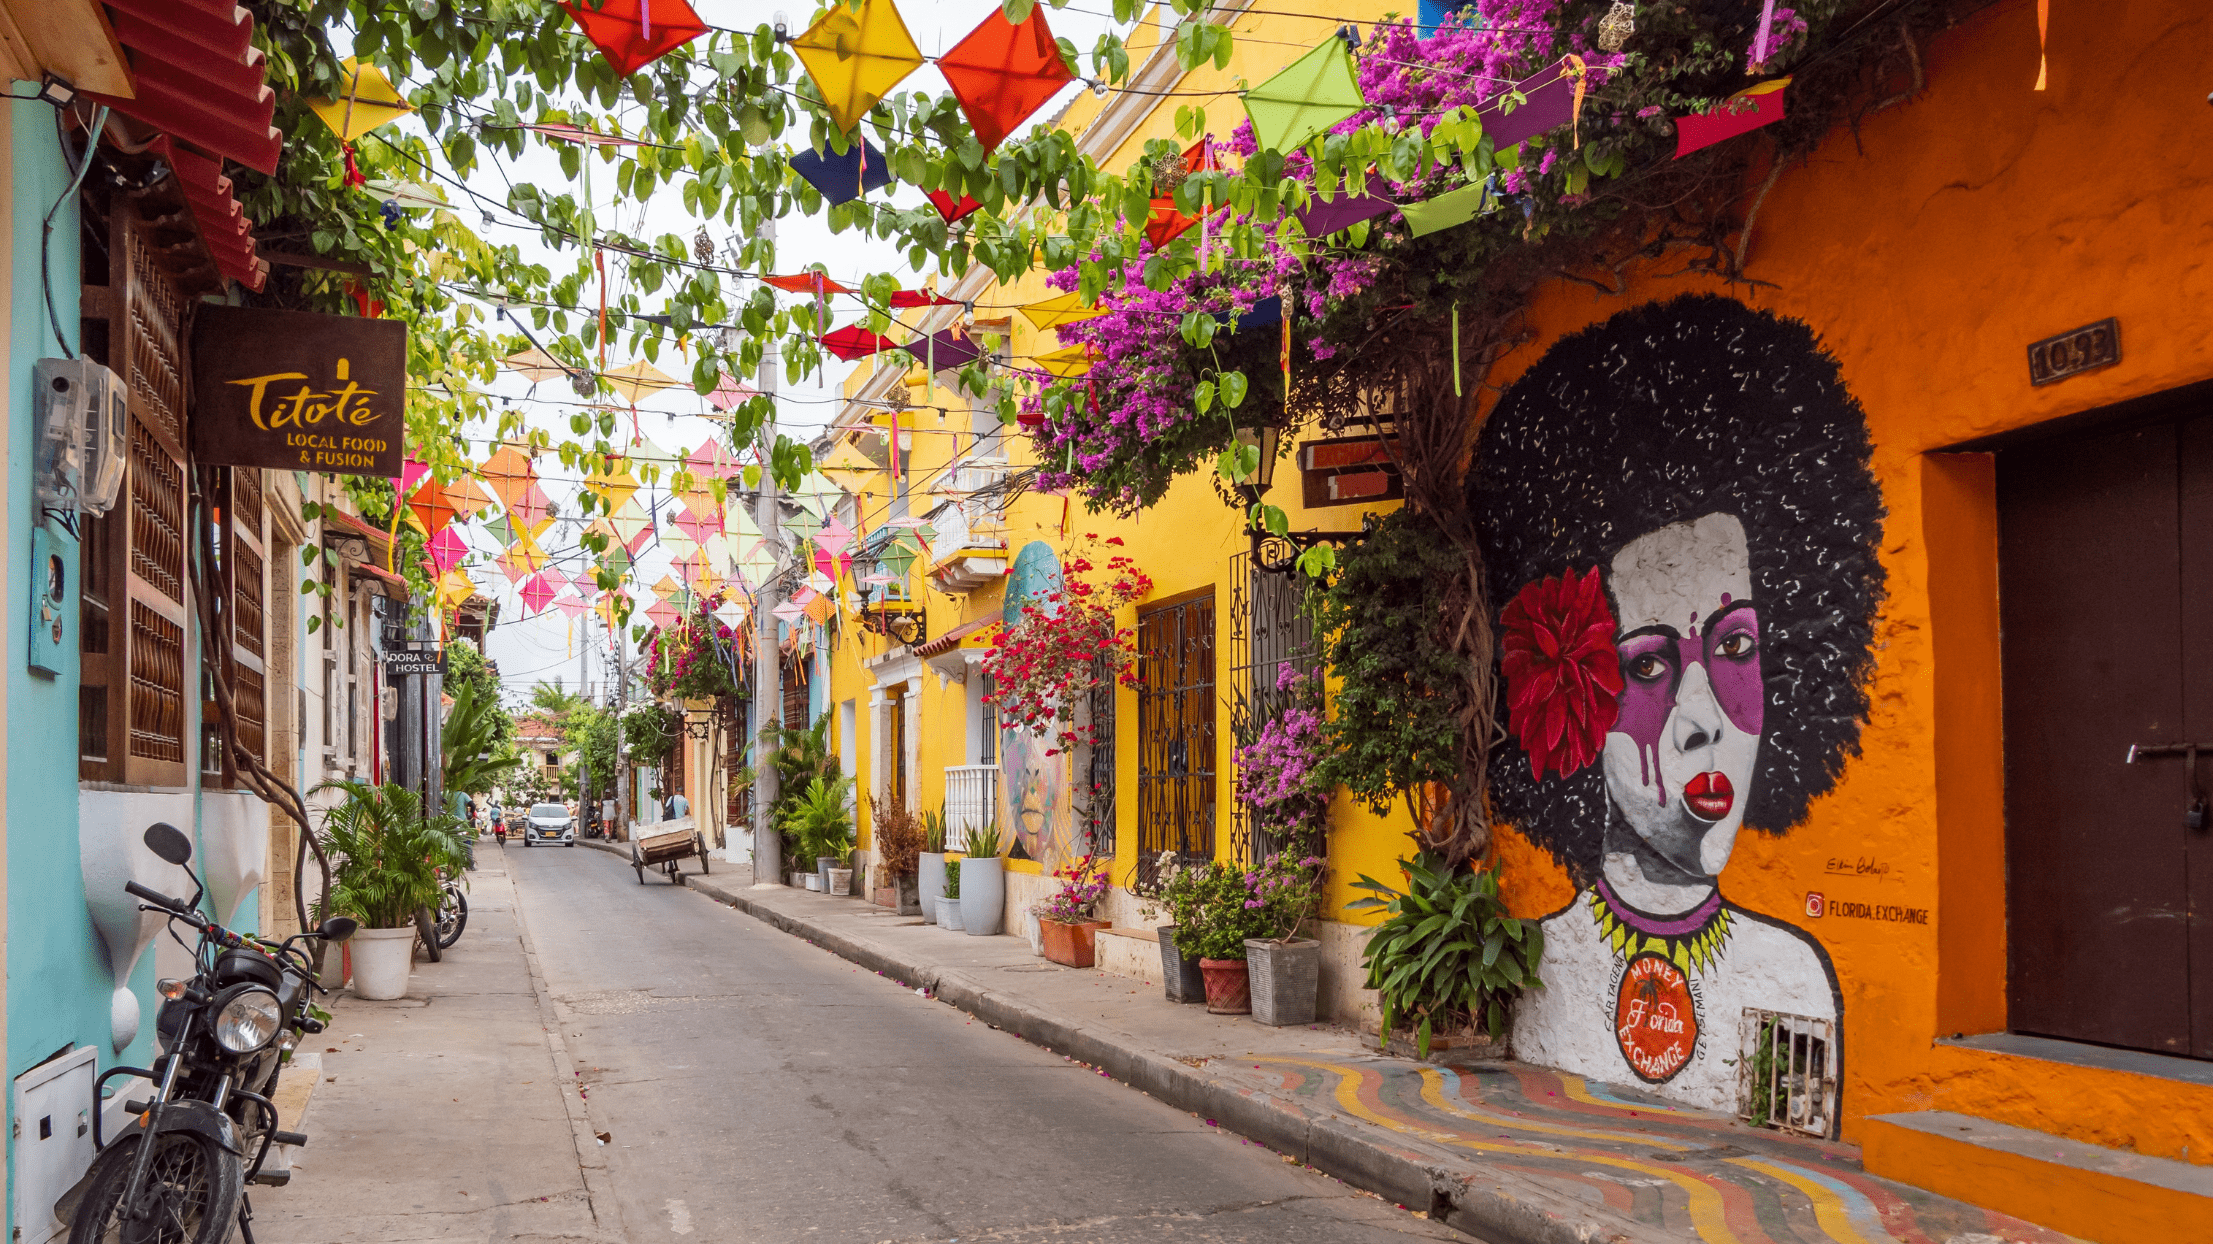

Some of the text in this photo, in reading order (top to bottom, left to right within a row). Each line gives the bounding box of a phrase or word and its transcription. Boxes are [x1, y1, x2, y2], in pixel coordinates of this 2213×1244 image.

[224, 371, 386, 430] Titoté
[287, 433, 387, 452] LOCAL FOOD
[300, 450, 375, 467] & FUSION
[395, 663, 439, 672] HOSTEL
[1829, 900, 1929, 925] FLORIDA.EXCHANGE
[1630, 957, 1684, 989] MONEY
[1604, 955, 1625, 1032] CARTAGENA
[1690, 978, 1707, 1061] GETSEMANI
[1619, 1025, 1685, 1075] EXCHANGE
